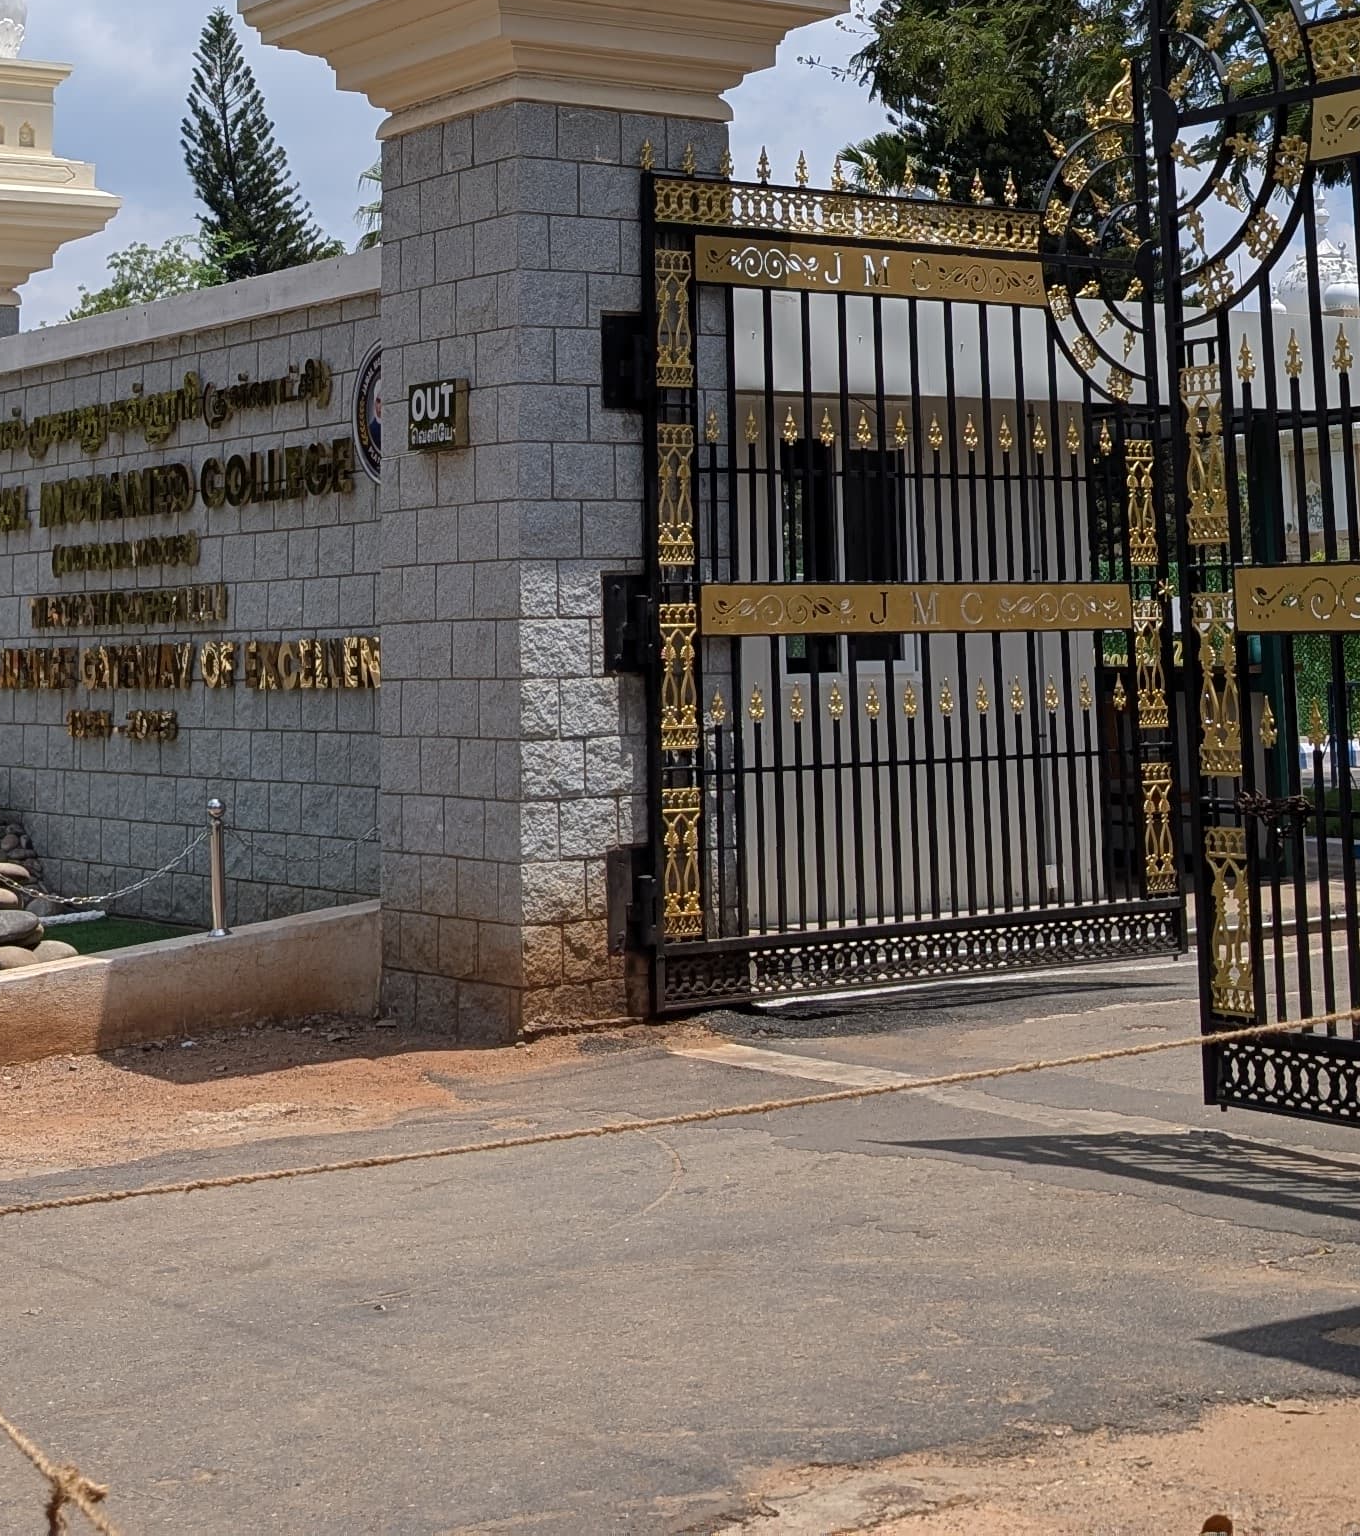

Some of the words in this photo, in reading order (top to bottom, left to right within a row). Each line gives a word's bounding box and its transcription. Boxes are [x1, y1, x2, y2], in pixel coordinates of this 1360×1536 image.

[411, 383, 454, 422] OUT
[39, 462, 196, 528] MOHAMED
[200, 437, 356, 508] COLLEGE
[79, 643, 192, 690] GATEWAY
[200, 640, 235, 689] OF
[245, 636, 382, 690] EXCELLEN
